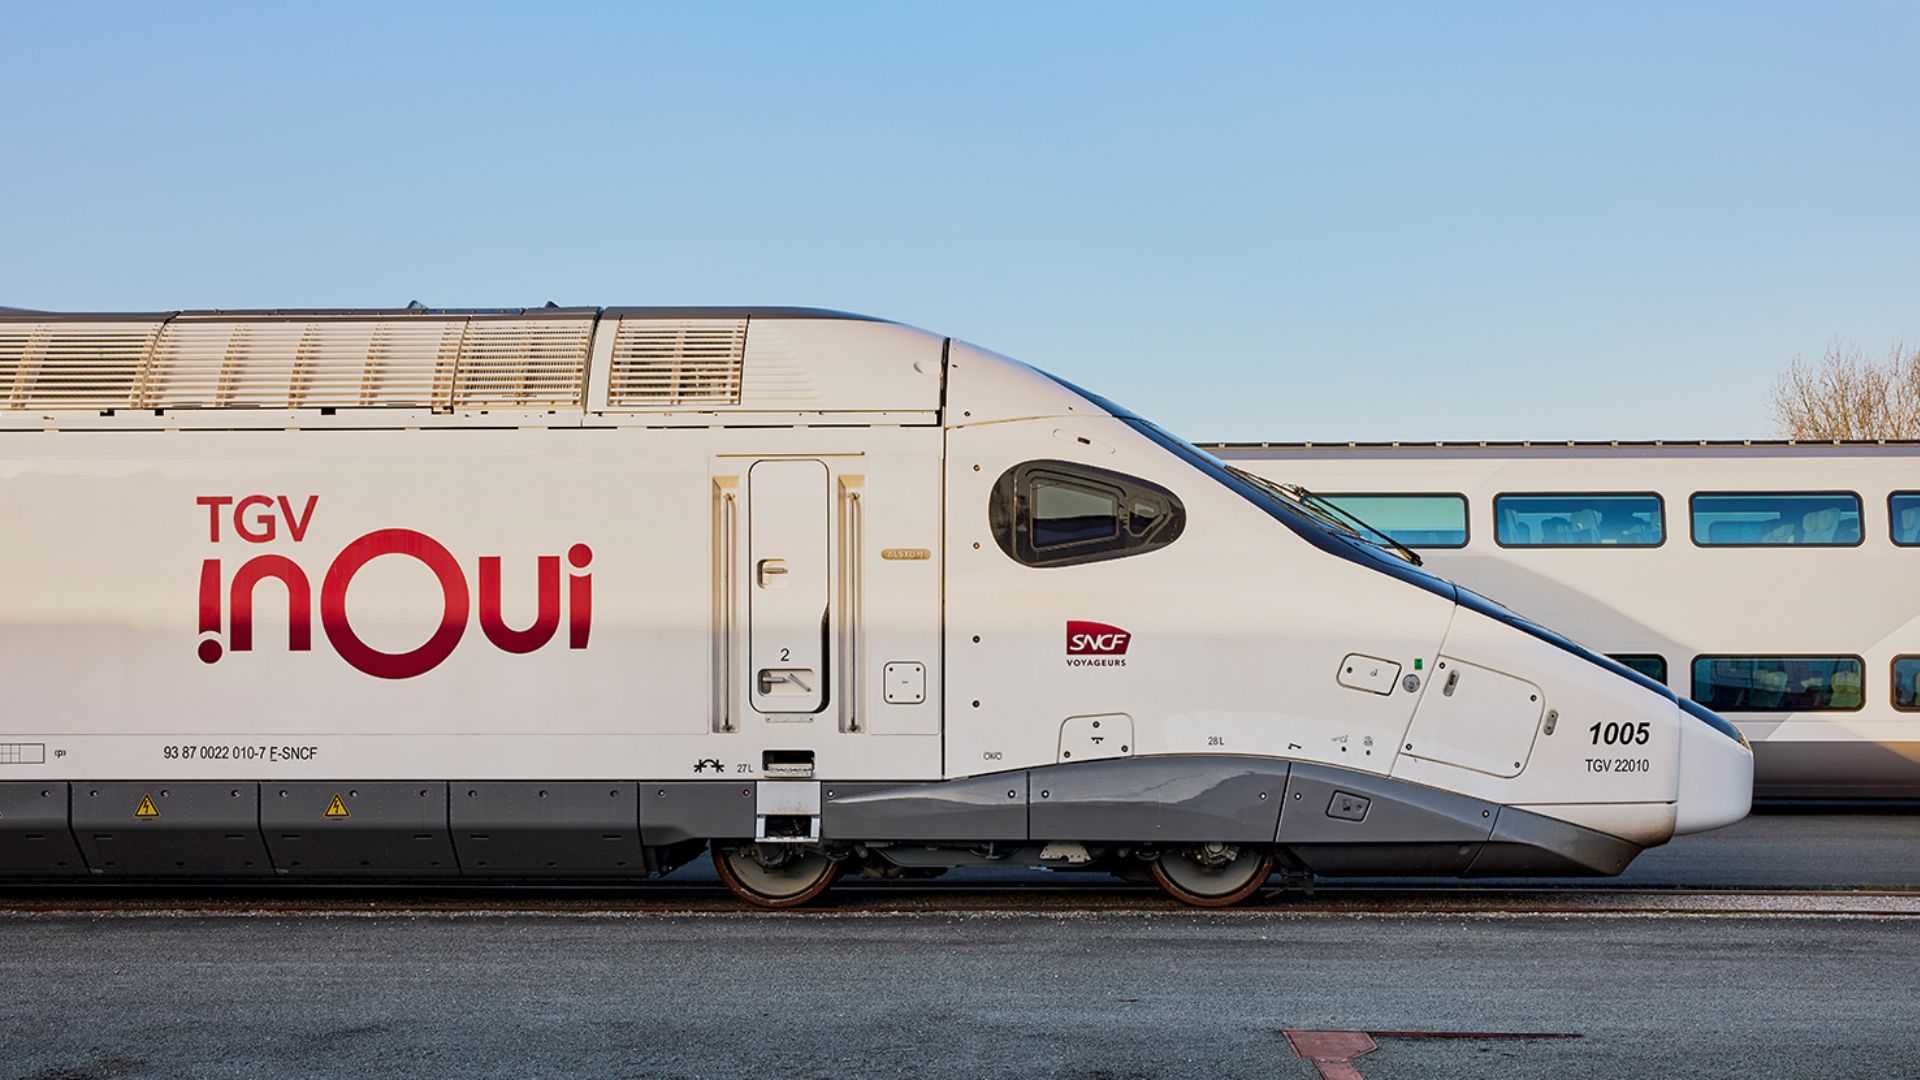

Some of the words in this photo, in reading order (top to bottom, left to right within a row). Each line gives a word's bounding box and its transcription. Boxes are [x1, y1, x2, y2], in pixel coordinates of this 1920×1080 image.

[197, 495, 319, 543] TGV
[1069, 634, 1127, 651] SNCF
[780, 648, 790, 662] 2
[1066, 659, 1127, 667] VOYAGEURS
[1589, 721, 1651, 745] 1005
[163, 746, 179, 760] 93
[181, 746, 197, 760] 87
[200, 746, 229, 760] 0022
[232, 746, 266, 760] 010-7
[1585, 758, 1612, 773] TGV
[1614, 758, 1650, 773] 22010
